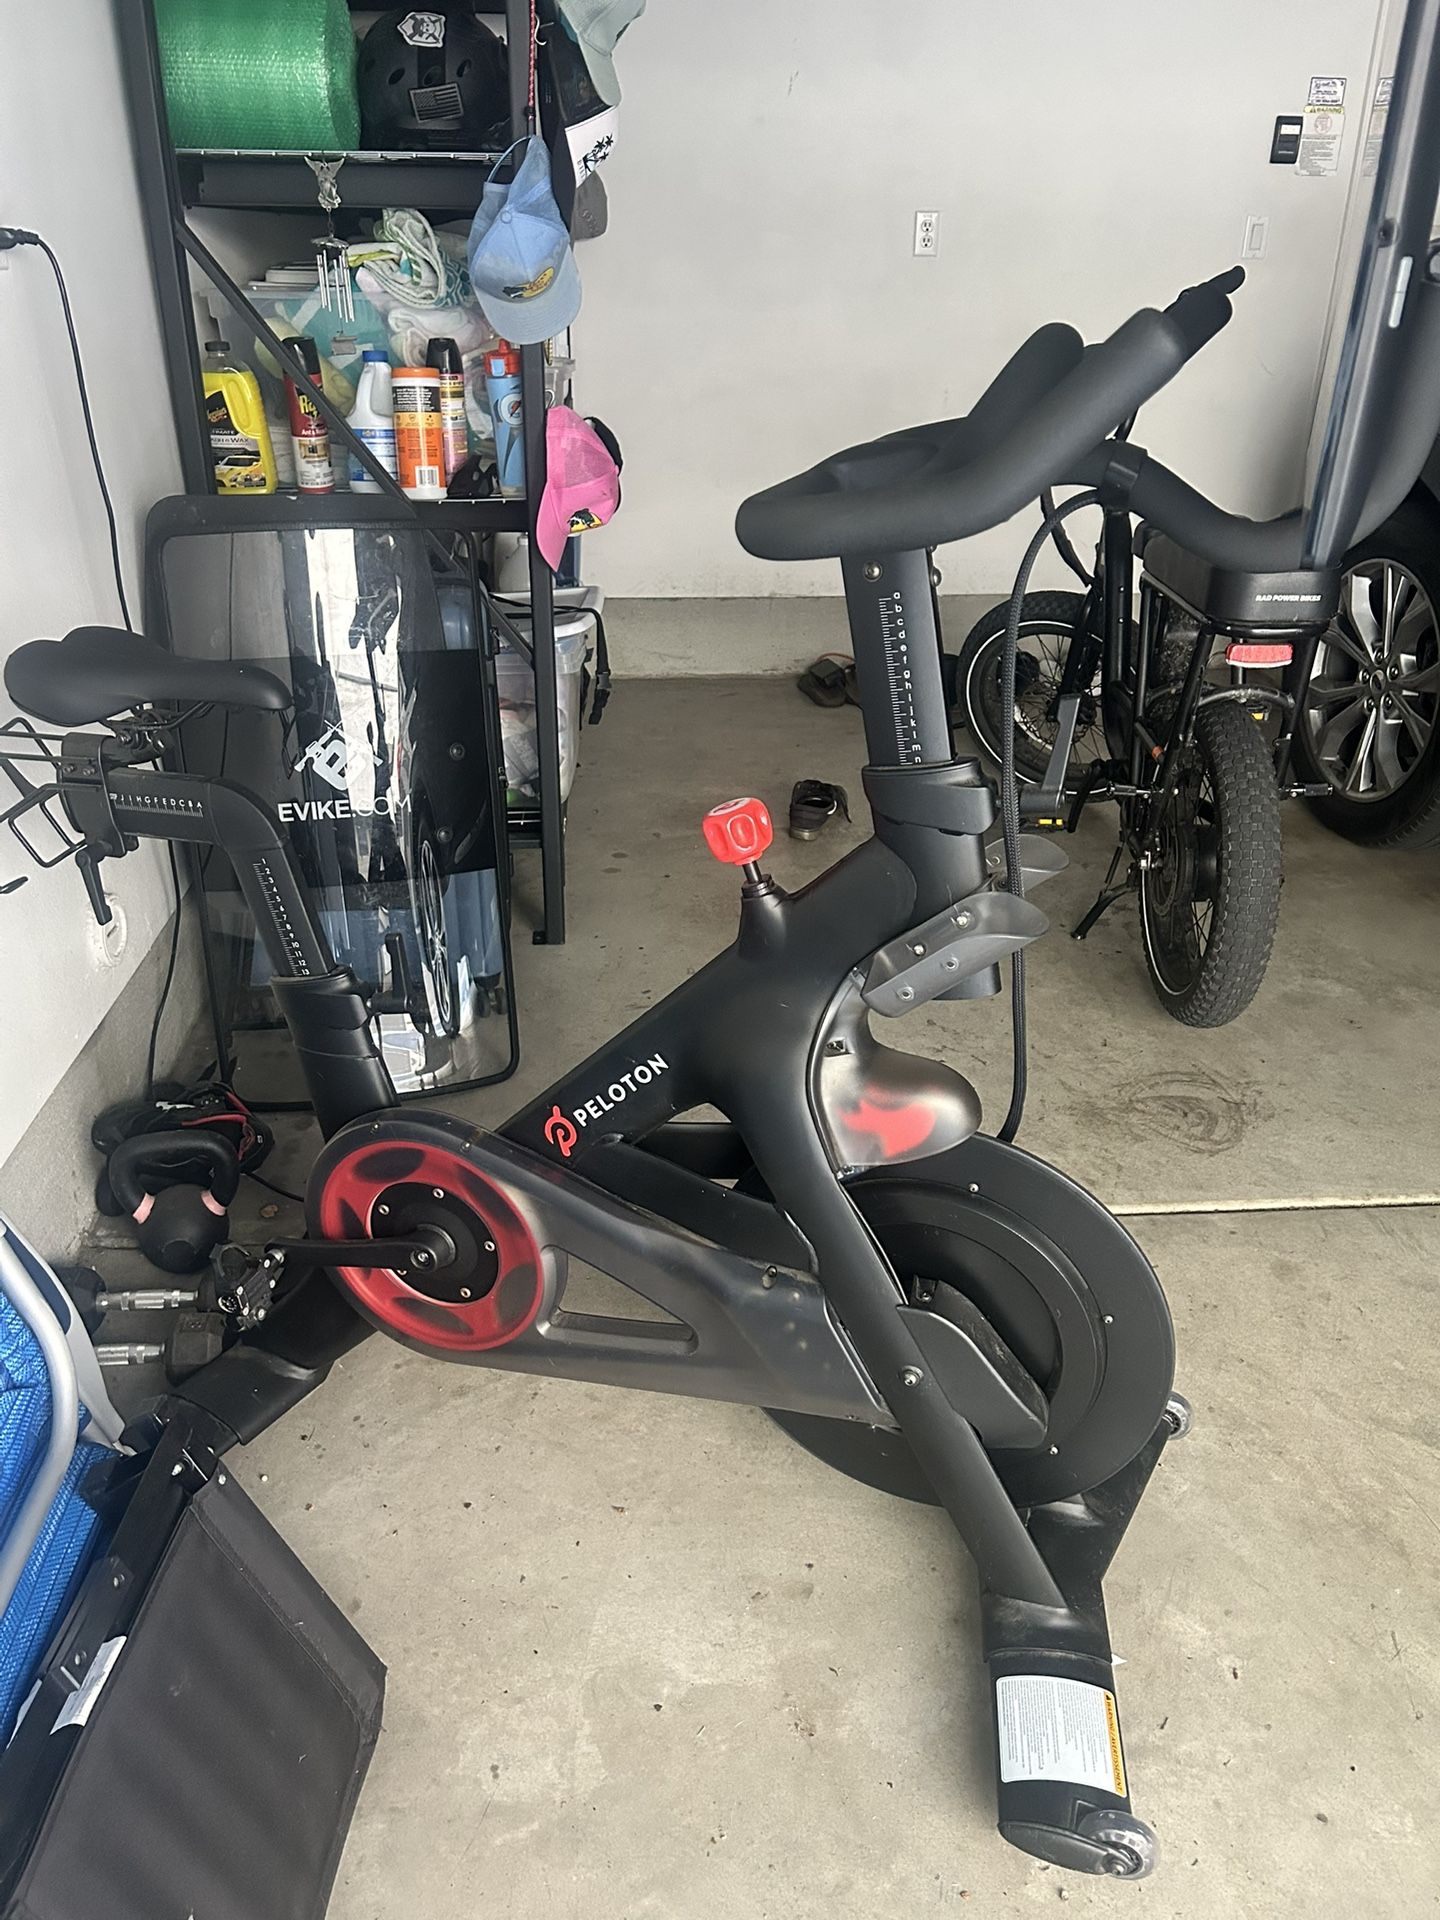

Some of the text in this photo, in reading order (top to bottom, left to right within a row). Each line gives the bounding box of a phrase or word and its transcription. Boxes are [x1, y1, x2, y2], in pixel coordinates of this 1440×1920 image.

[1273, 594, 1300, 602] POWER
[1300, 594, 1322, 602] BIKES
[277, 795, 412, 823] EVIKE.COM
[572, 1053, 669, 1128] PELOTON
